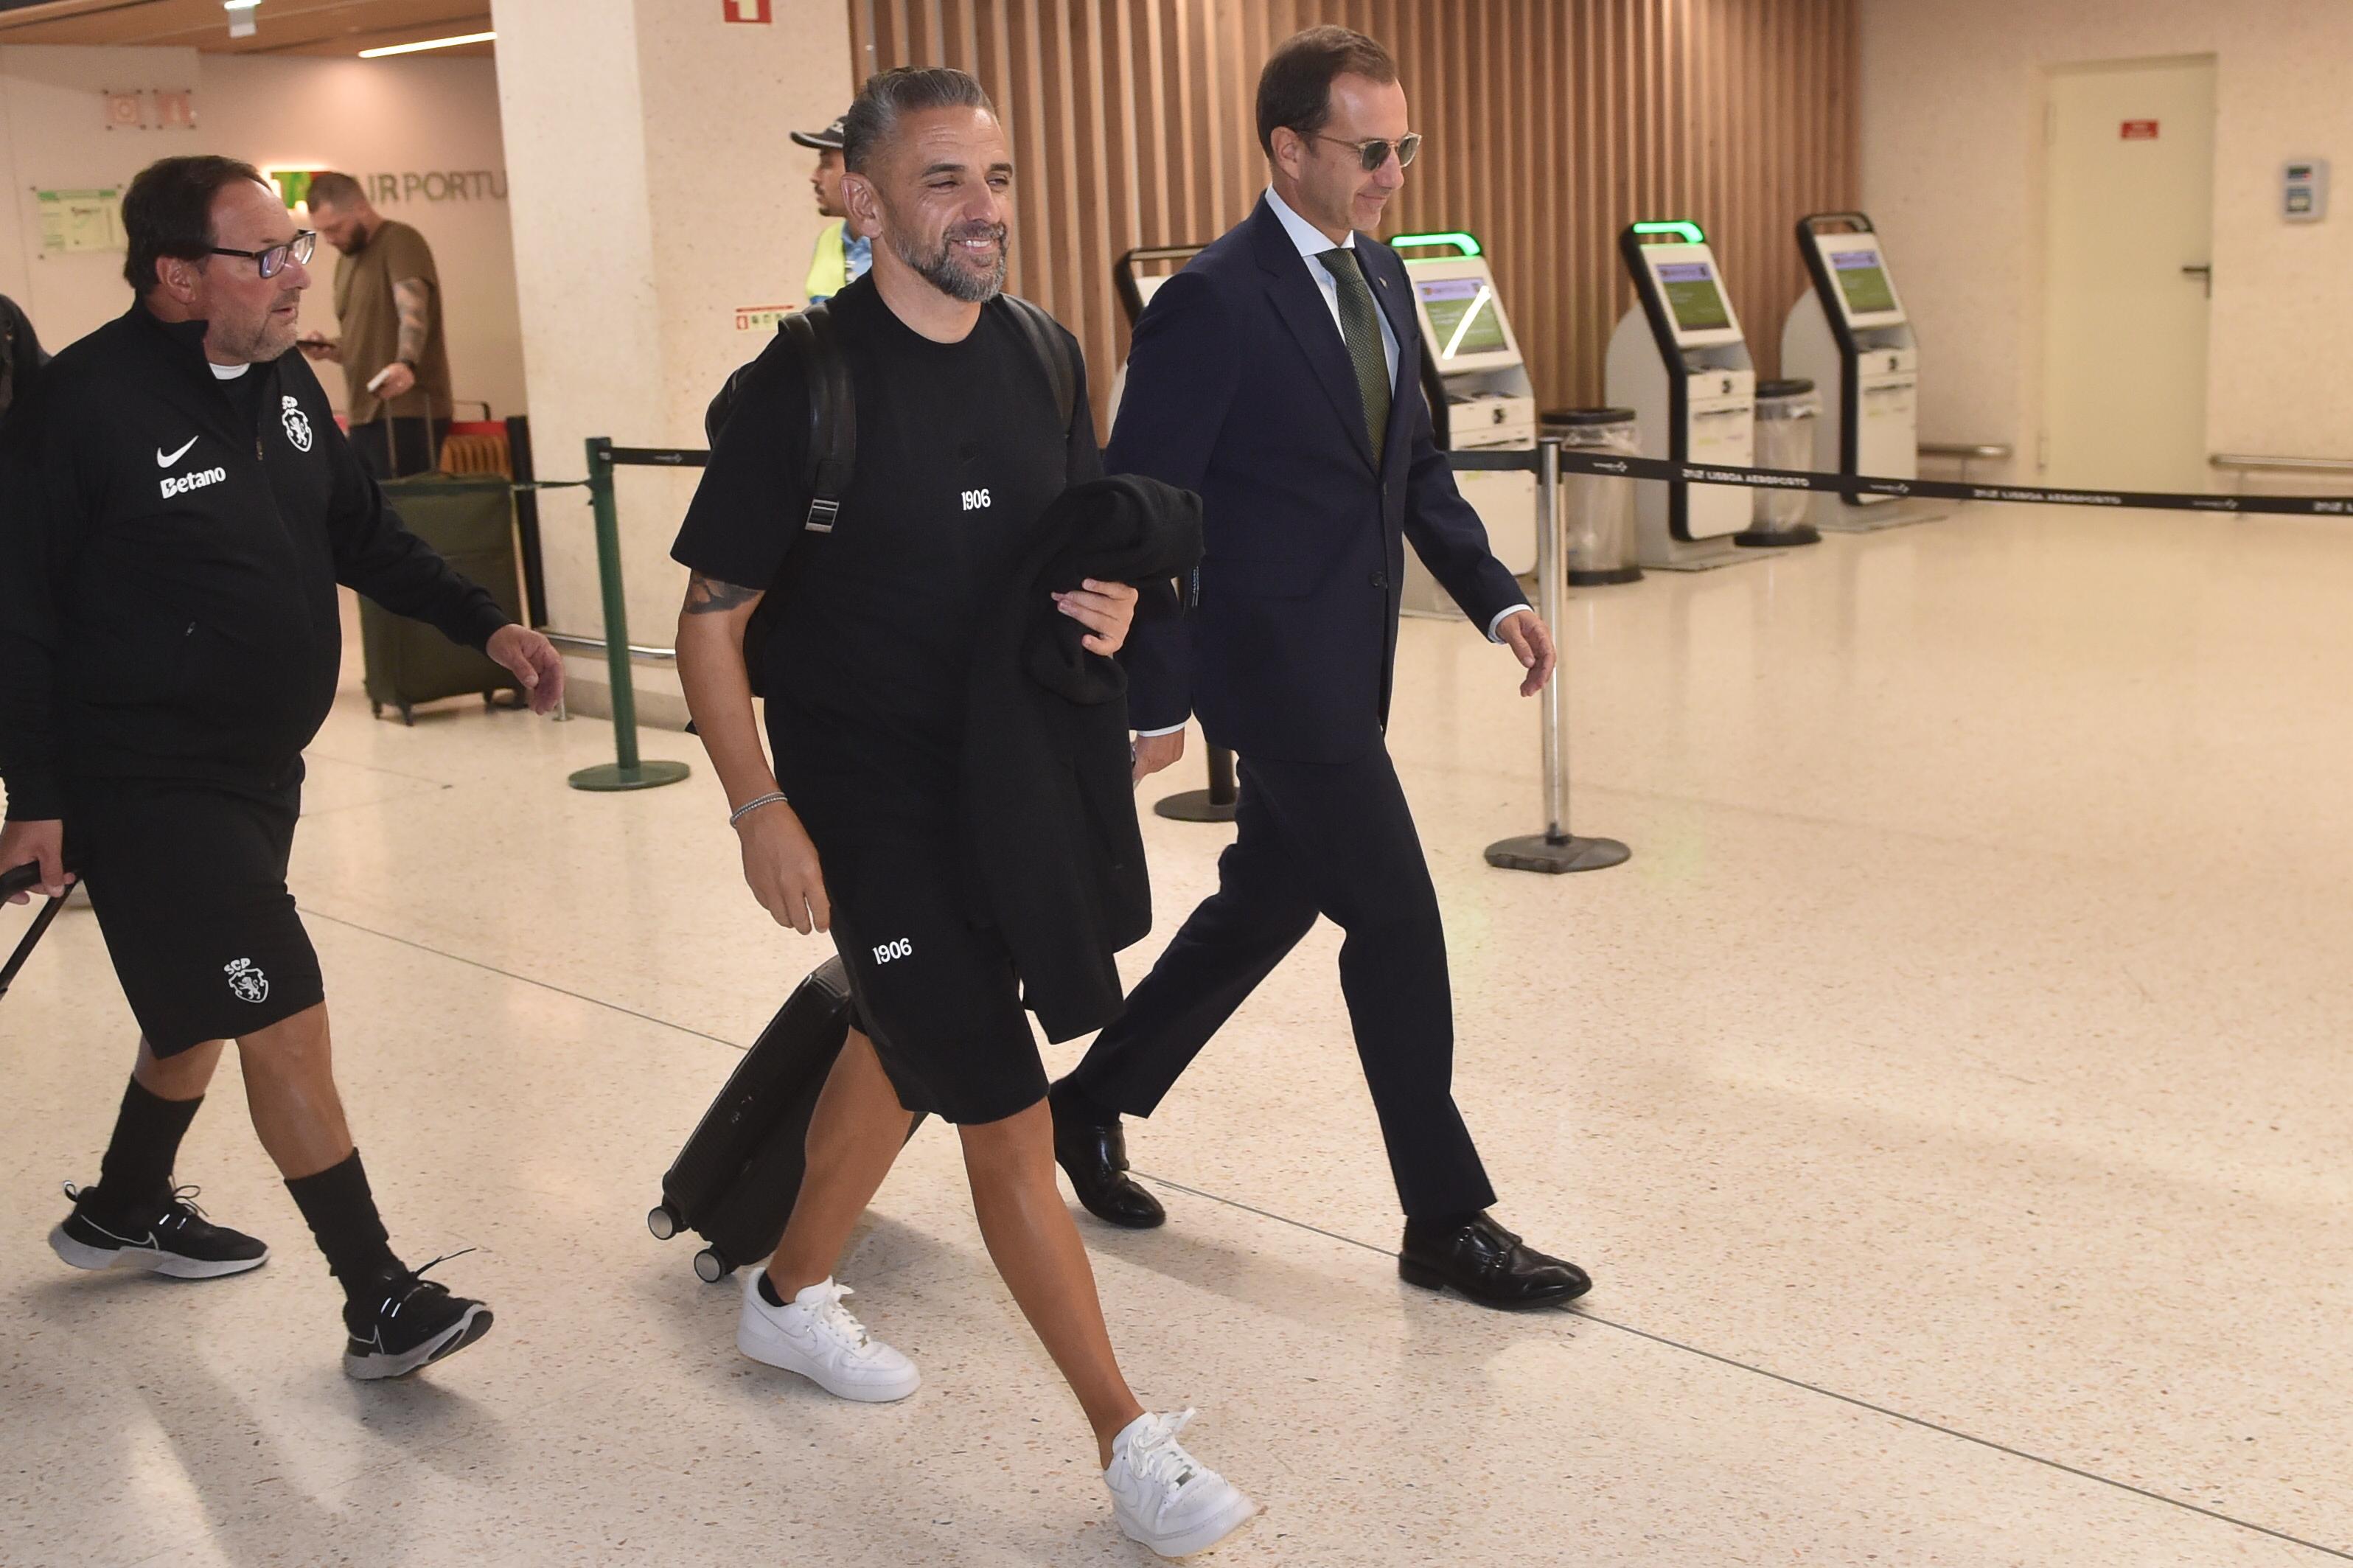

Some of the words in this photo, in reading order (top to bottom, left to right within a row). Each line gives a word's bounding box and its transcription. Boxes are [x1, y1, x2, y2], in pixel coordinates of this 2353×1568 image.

[367, 173, 399, 203] IR
[404, 170, 508, 201] PORTU
[160, 467, 226, 499] Betano
[961, 488, 991, 510] 1906
[872, 938, 912, 965] 1906
[223, 958, 251, 975] SCP
